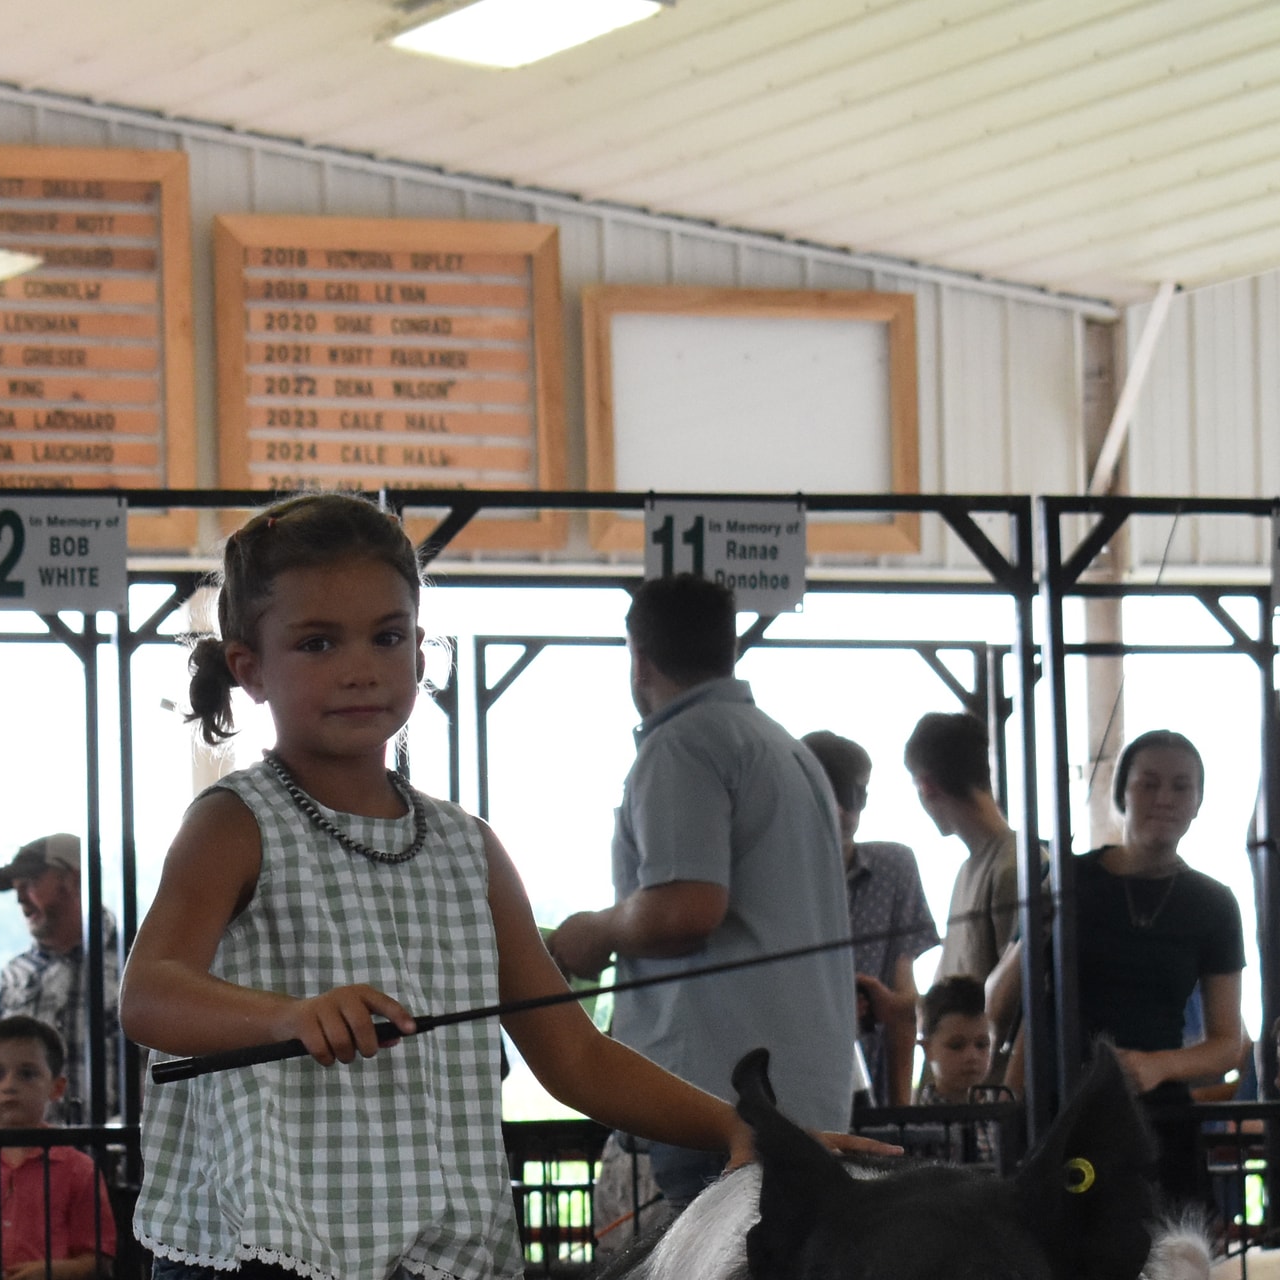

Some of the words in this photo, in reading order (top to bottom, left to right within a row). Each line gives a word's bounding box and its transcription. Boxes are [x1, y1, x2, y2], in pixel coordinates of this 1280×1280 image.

[262, 247, 308, 267] 2018
[263, 281, 308, 299] 2019
[4, 314, 80, 333] LENSMAN
[264, 313, 317, 332] 2020
[390, 318, 453, 335] CONRAD
[264, 345, 311, 363] 2021
[265, 376, 317, 395] 2022
[392, 381, 449, 399] WILSON
[266, 409, 318, 427] 2023
[340, 412, 384, 430] CALE
[405, 413, 449, 432] HALL
[267, 442, 318, 461] 2024
[340, 445, 385, 464] CALE
[403, 447, 450, 466] HALL
[47, 515, 102, 530] Memory
[105, 516, 120, 528] of
[725, 520, 782, 537] Memory
[786, 521, 801, 533] of
[49, 536, 90, 557] BOB
[652, 514, 705, 580] 11
[726, 540, 780, 560] Ranae
[38, 566, 100, 588] WHITE
[714, 569, 791, 590] Donohoe
